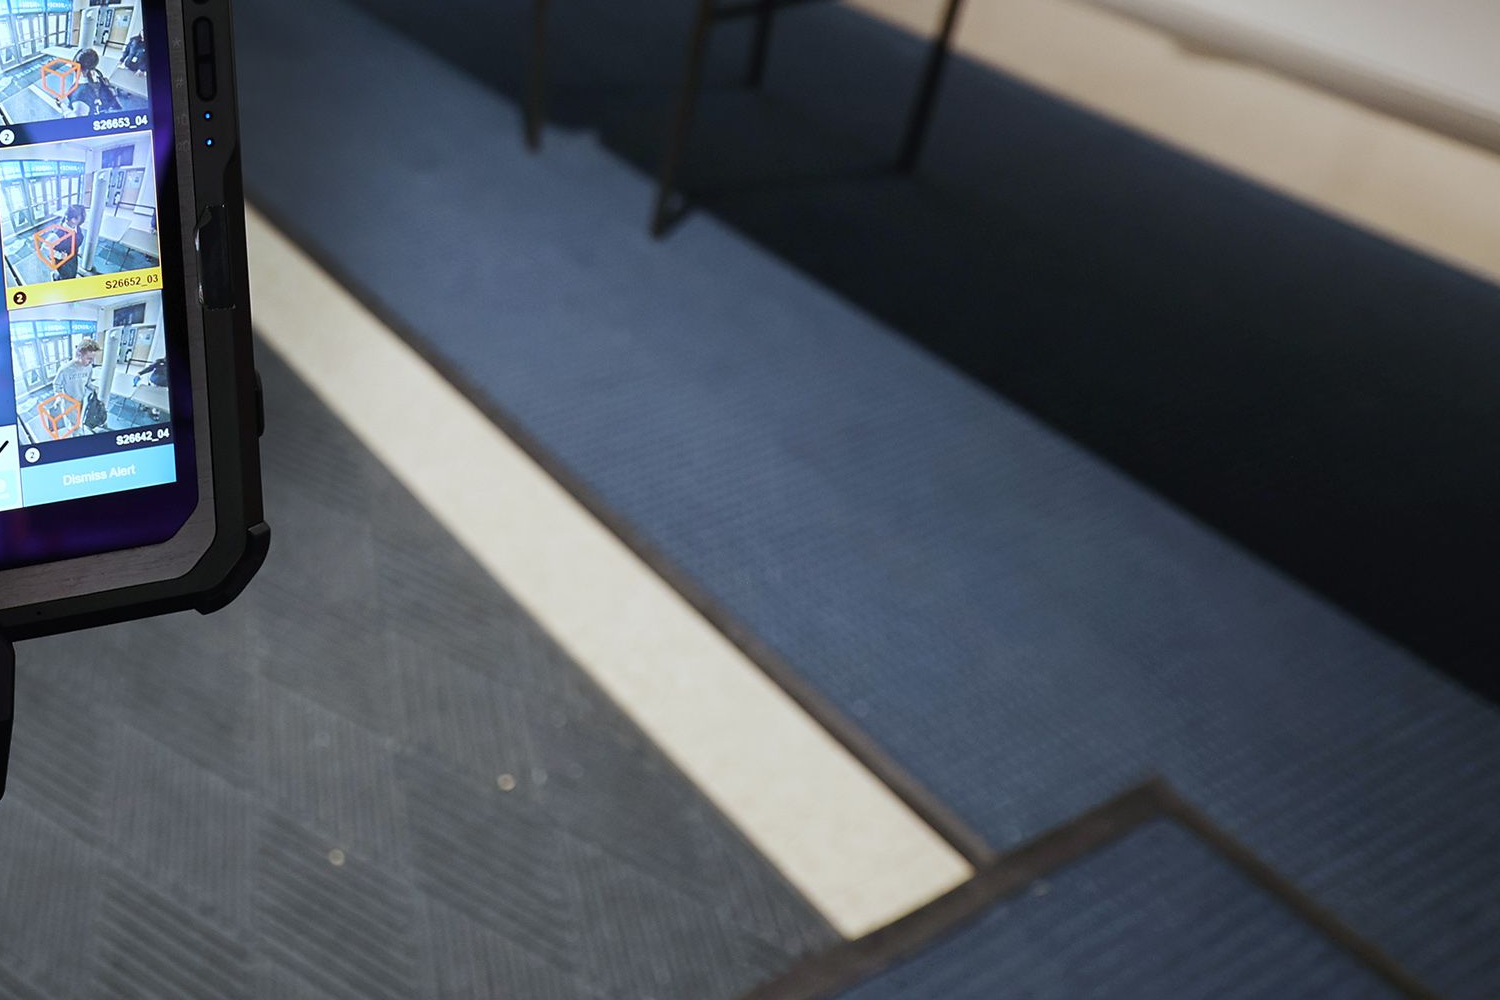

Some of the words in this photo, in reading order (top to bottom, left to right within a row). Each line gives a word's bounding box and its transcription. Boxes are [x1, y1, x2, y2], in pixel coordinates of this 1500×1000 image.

[93, 115, 148, 131] S26653_04
[105, 274, 159, 289] S26652_03
[16, 293, 24, 303] 2
[116, 428, 170, 446] S26642_04
[63, 470, 107, 486] Dismiss
[109, 464, 136, 478] Alert
